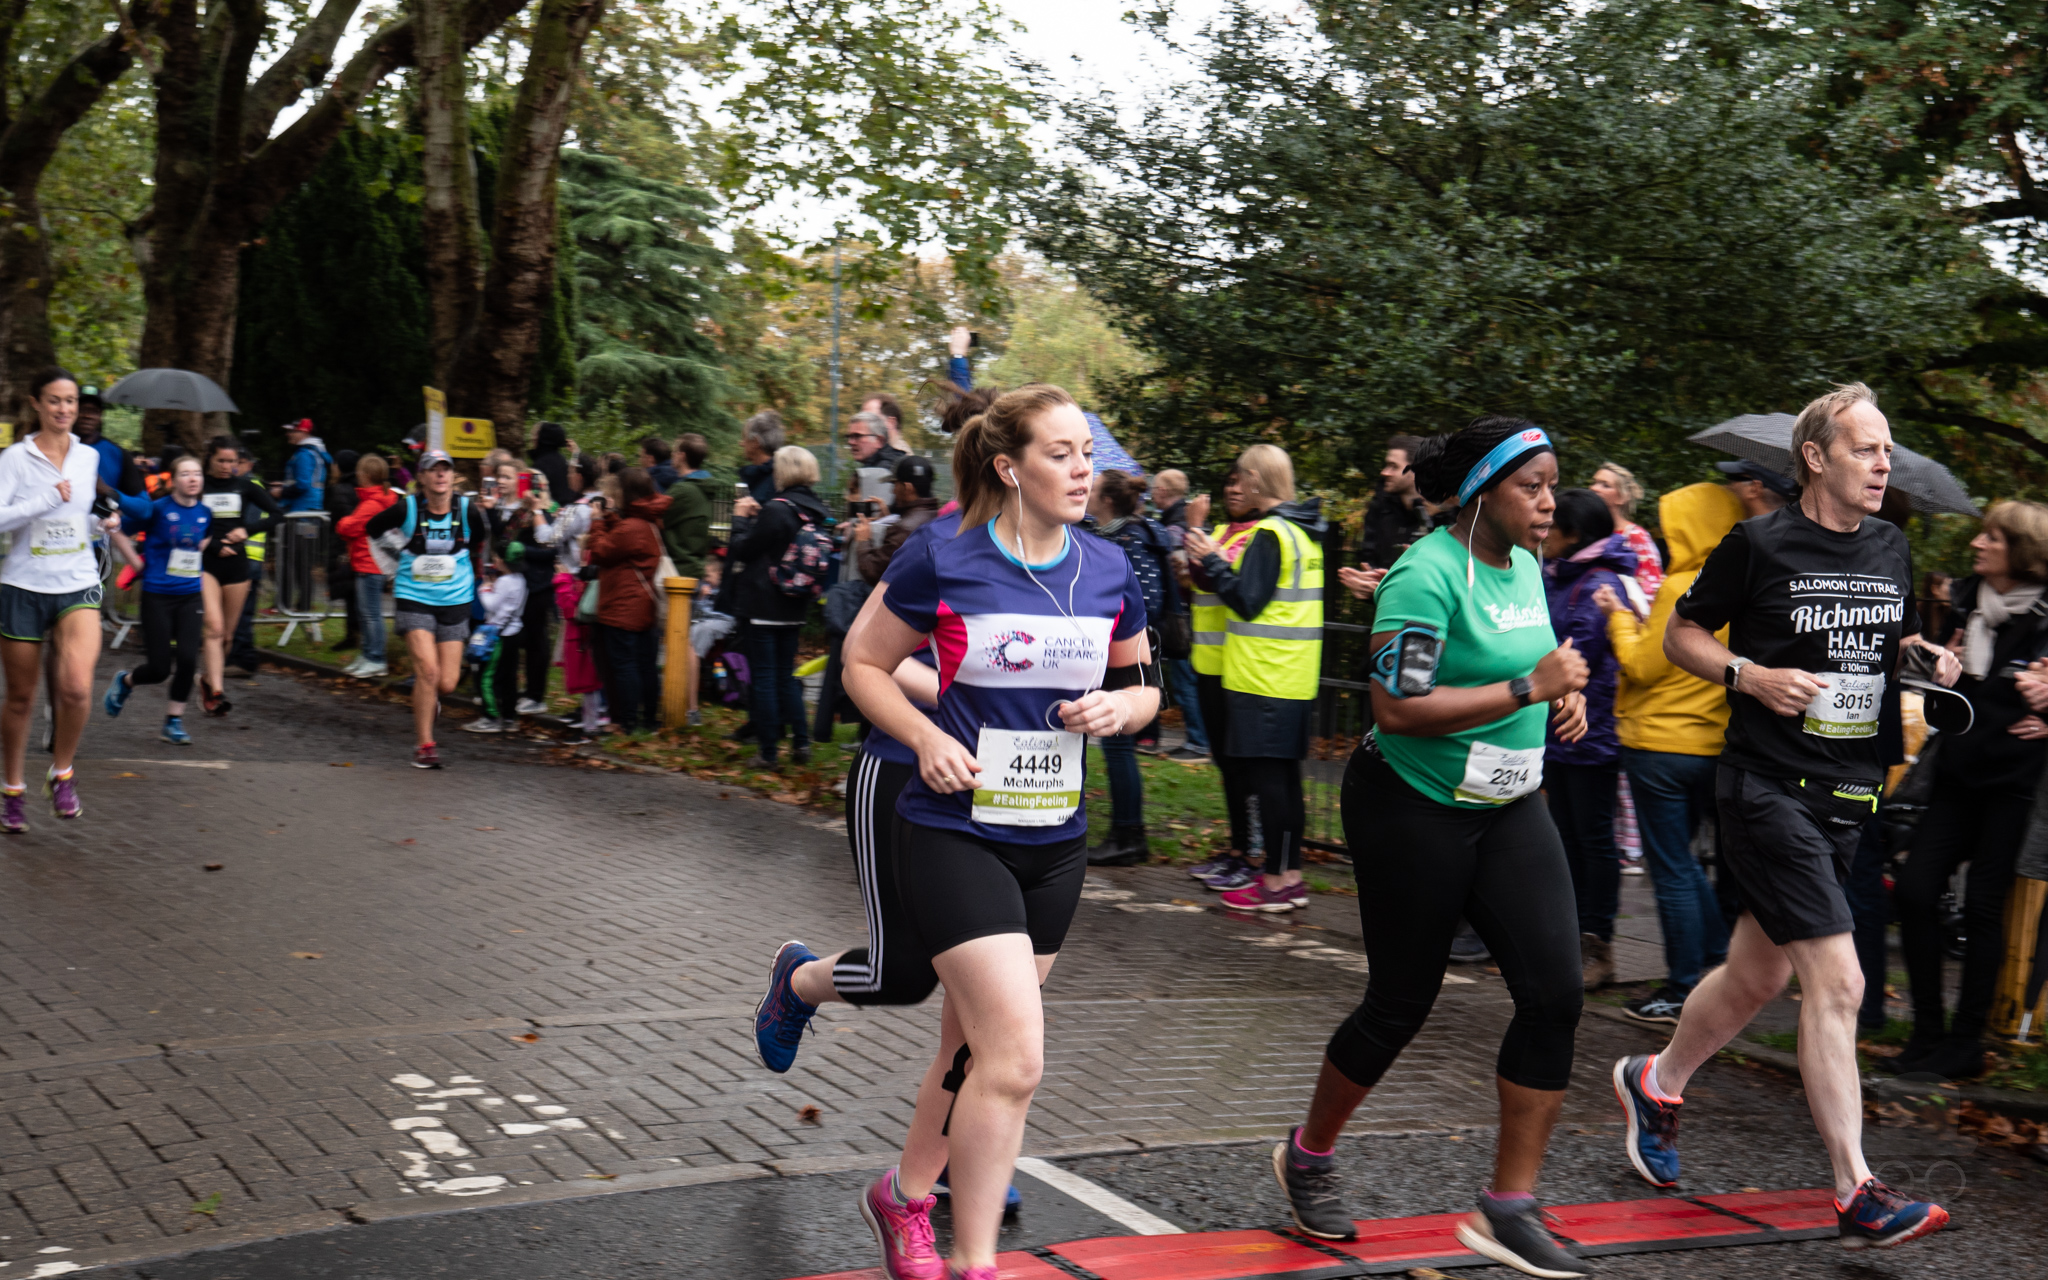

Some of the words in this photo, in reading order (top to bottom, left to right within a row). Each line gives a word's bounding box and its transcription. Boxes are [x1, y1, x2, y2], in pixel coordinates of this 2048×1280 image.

[1789, 579, 1848, 592] SALOMON
[1790, 596, 1905, 634] Richmond
[1044, 635, 1094, 648] CANCER
[1828, 631, 1885, 651] HALF
[1044, 647, 1104, 661] RESEARCH
[1828, 650, 1882, 662] MARATHON
[1042, 658, 1060, 670] UK
[1840, 662, 1869, 673] &10km
[1833, 693, 1874, 709] 3015
[1846, 711, 1860, 719] Ian
[1009, 754, 1062, 774] 4449
[1003, 776, 1064, 790] McMurphs
[1488, 768, 1529, 786] 2314
[992, 793, 1068, 809] #EalingFeeling
